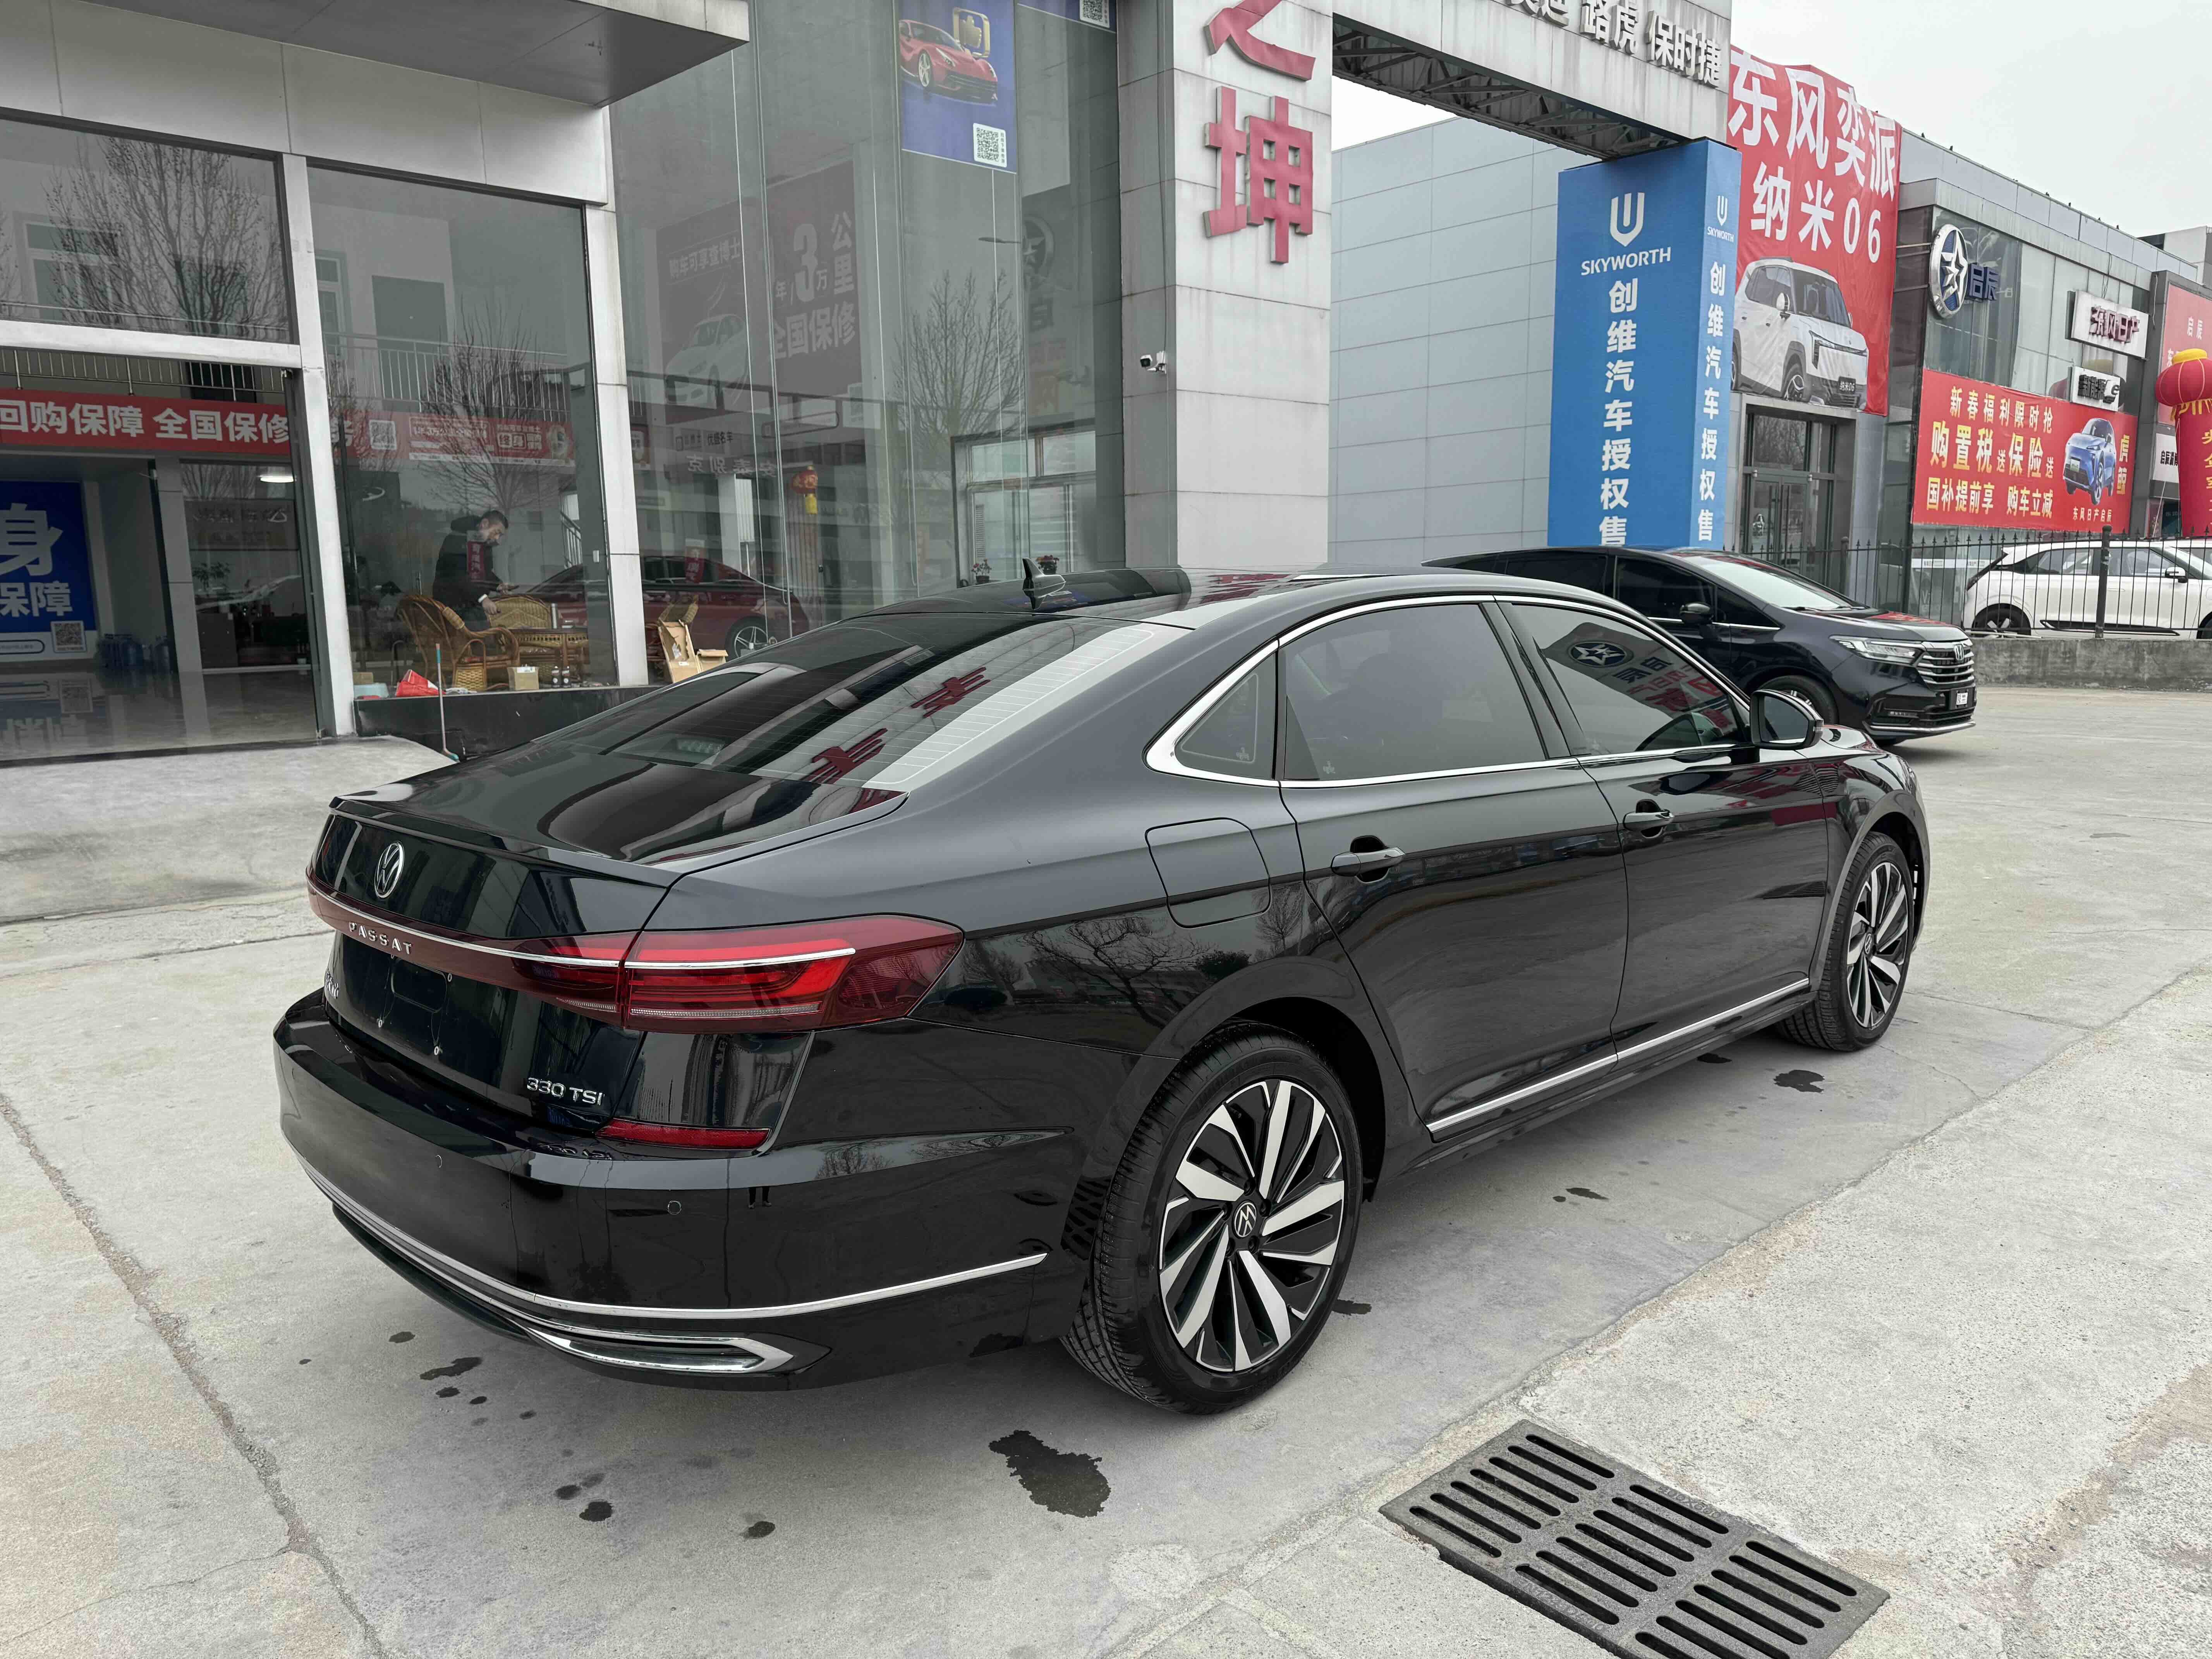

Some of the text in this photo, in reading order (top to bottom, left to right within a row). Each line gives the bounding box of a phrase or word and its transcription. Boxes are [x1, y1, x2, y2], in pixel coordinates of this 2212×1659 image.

[1580, 0, 1638, 54] 路虎
[1646, 10, 1722, 88] 保时捷
[1728, 50, 1896, 201] 东风奕派
[1751, 161, 1881, 263] 纳米06
[1707, 226, 1734, 242] SKYWORTH
[1581, 247, 1671, 276] SKYWORTH
[1968, 263, 1999, 301] 启辰
[2090, 306, 2140, 343] 东风日产
[0, 399, 144, 437] 回购保障
[153, 408, 290, 444] 全国保修
[1599, 278, 1638, 546] 创维汽车授权售
[1698, 262, 1726, 541] 创维汽车授权售
[1949, 386, 2053, 434] 新春福利限时抢
[1927, 477, 2054, 518] 国补提前享 购车立减
[2073, 507, 2112, 523] 东风日产启辰
[349, 922, 412, 955] PASSAT
[527, 1077, 603, 1106] 330 TSI
